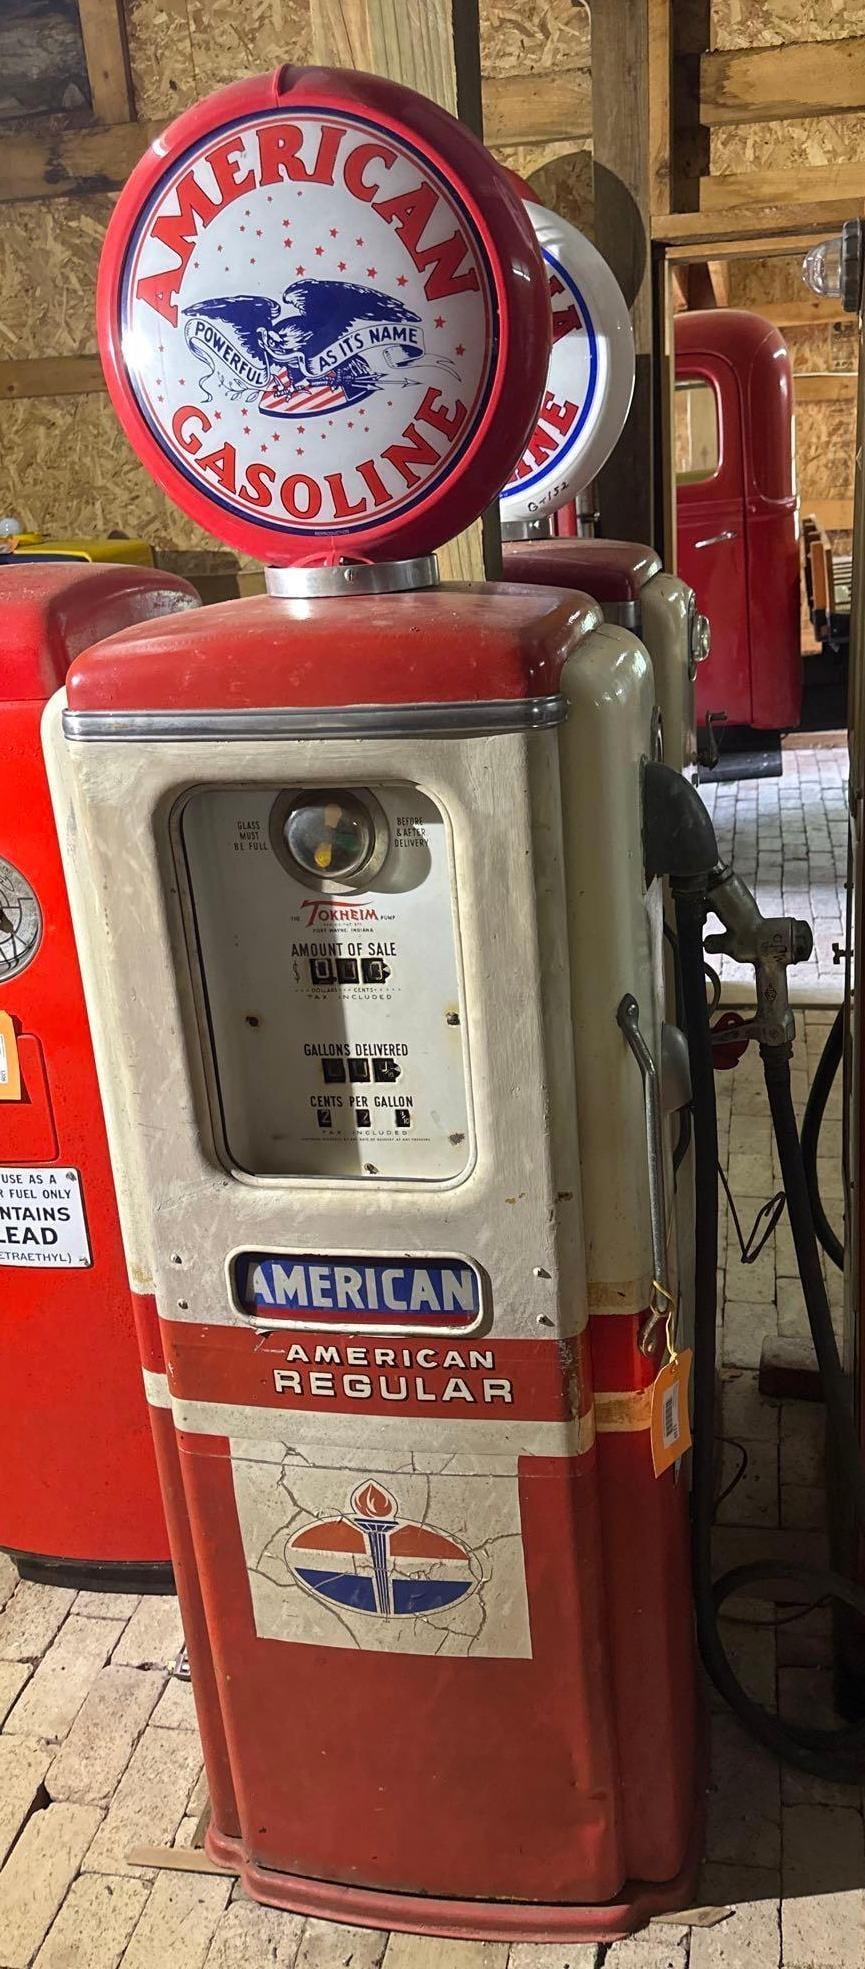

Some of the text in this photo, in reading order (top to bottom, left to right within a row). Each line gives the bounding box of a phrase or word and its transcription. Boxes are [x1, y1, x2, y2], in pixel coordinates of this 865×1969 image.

[136, 124, 481, 328] AMERICAN
[195, 320, 266, 386] POWERFUL
[319, 326, 418, 371] AS IT'S NAME
[172, 386, 468, 519] GASOLINE
[237, 821, 261, 830] GLASS
[396, 817, 424, 826] BEFORE
[239, 832, 260, 840] MUST
[404, 828, 426, 837] AFTER
[233, 842, 268, 851] BE FULL
[394, 838, 429, 848] DELIVERY
[300, 899, 379, 928] TOKHEIM
[291, 942, 397, 958] AMOUNT OF SALE
[303, 1043, 409, 1057] GALLONS DELIVERED
[310, 1096, 414, 1108] CENTS PER GALLON
[1, 1174, 57, 1184] USE AS A
[9, 1189, 37, 1199] FUEL
[42, 1189, 71, 1199] ONLY
[252, 1263, 475, 1311] AMERICAN
[285, 1343, 495, 1370] AMERICAN
[272, 1368, 514, 1404] REGULAR
